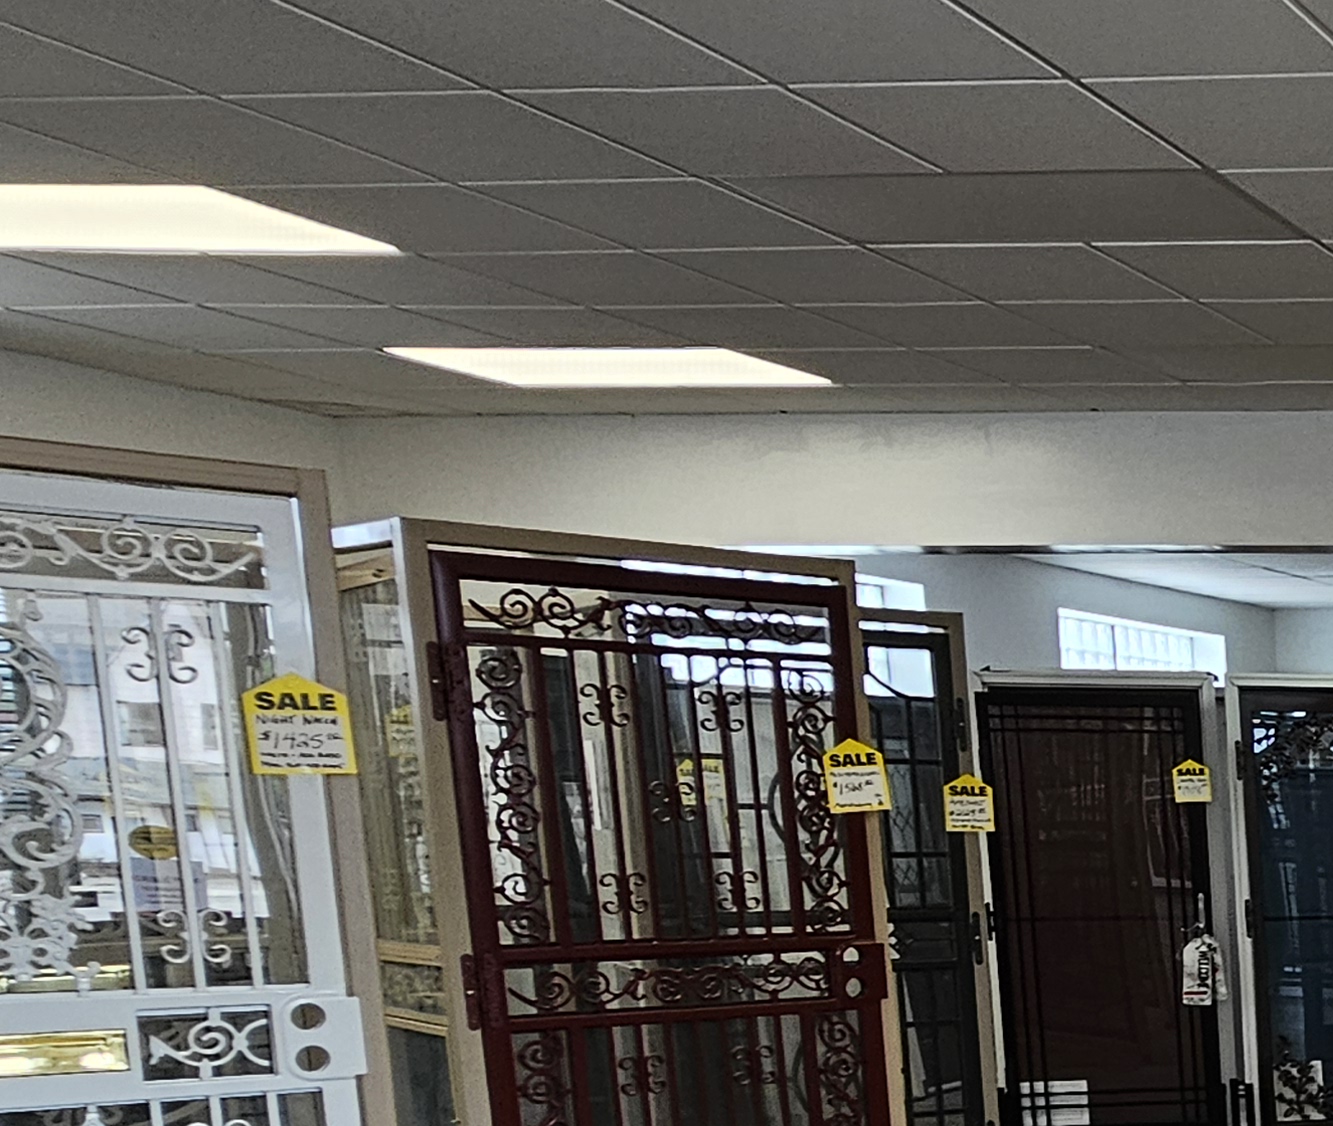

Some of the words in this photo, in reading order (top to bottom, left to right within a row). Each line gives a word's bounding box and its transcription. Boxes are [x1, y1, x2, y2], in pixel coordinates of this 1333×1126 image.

[254, 691, 338, 711] SALE
[829, 752, 878, 767] SALE
[1176, 768, 1206, 777] SALE
[948, 785, 989, 797] SALE
